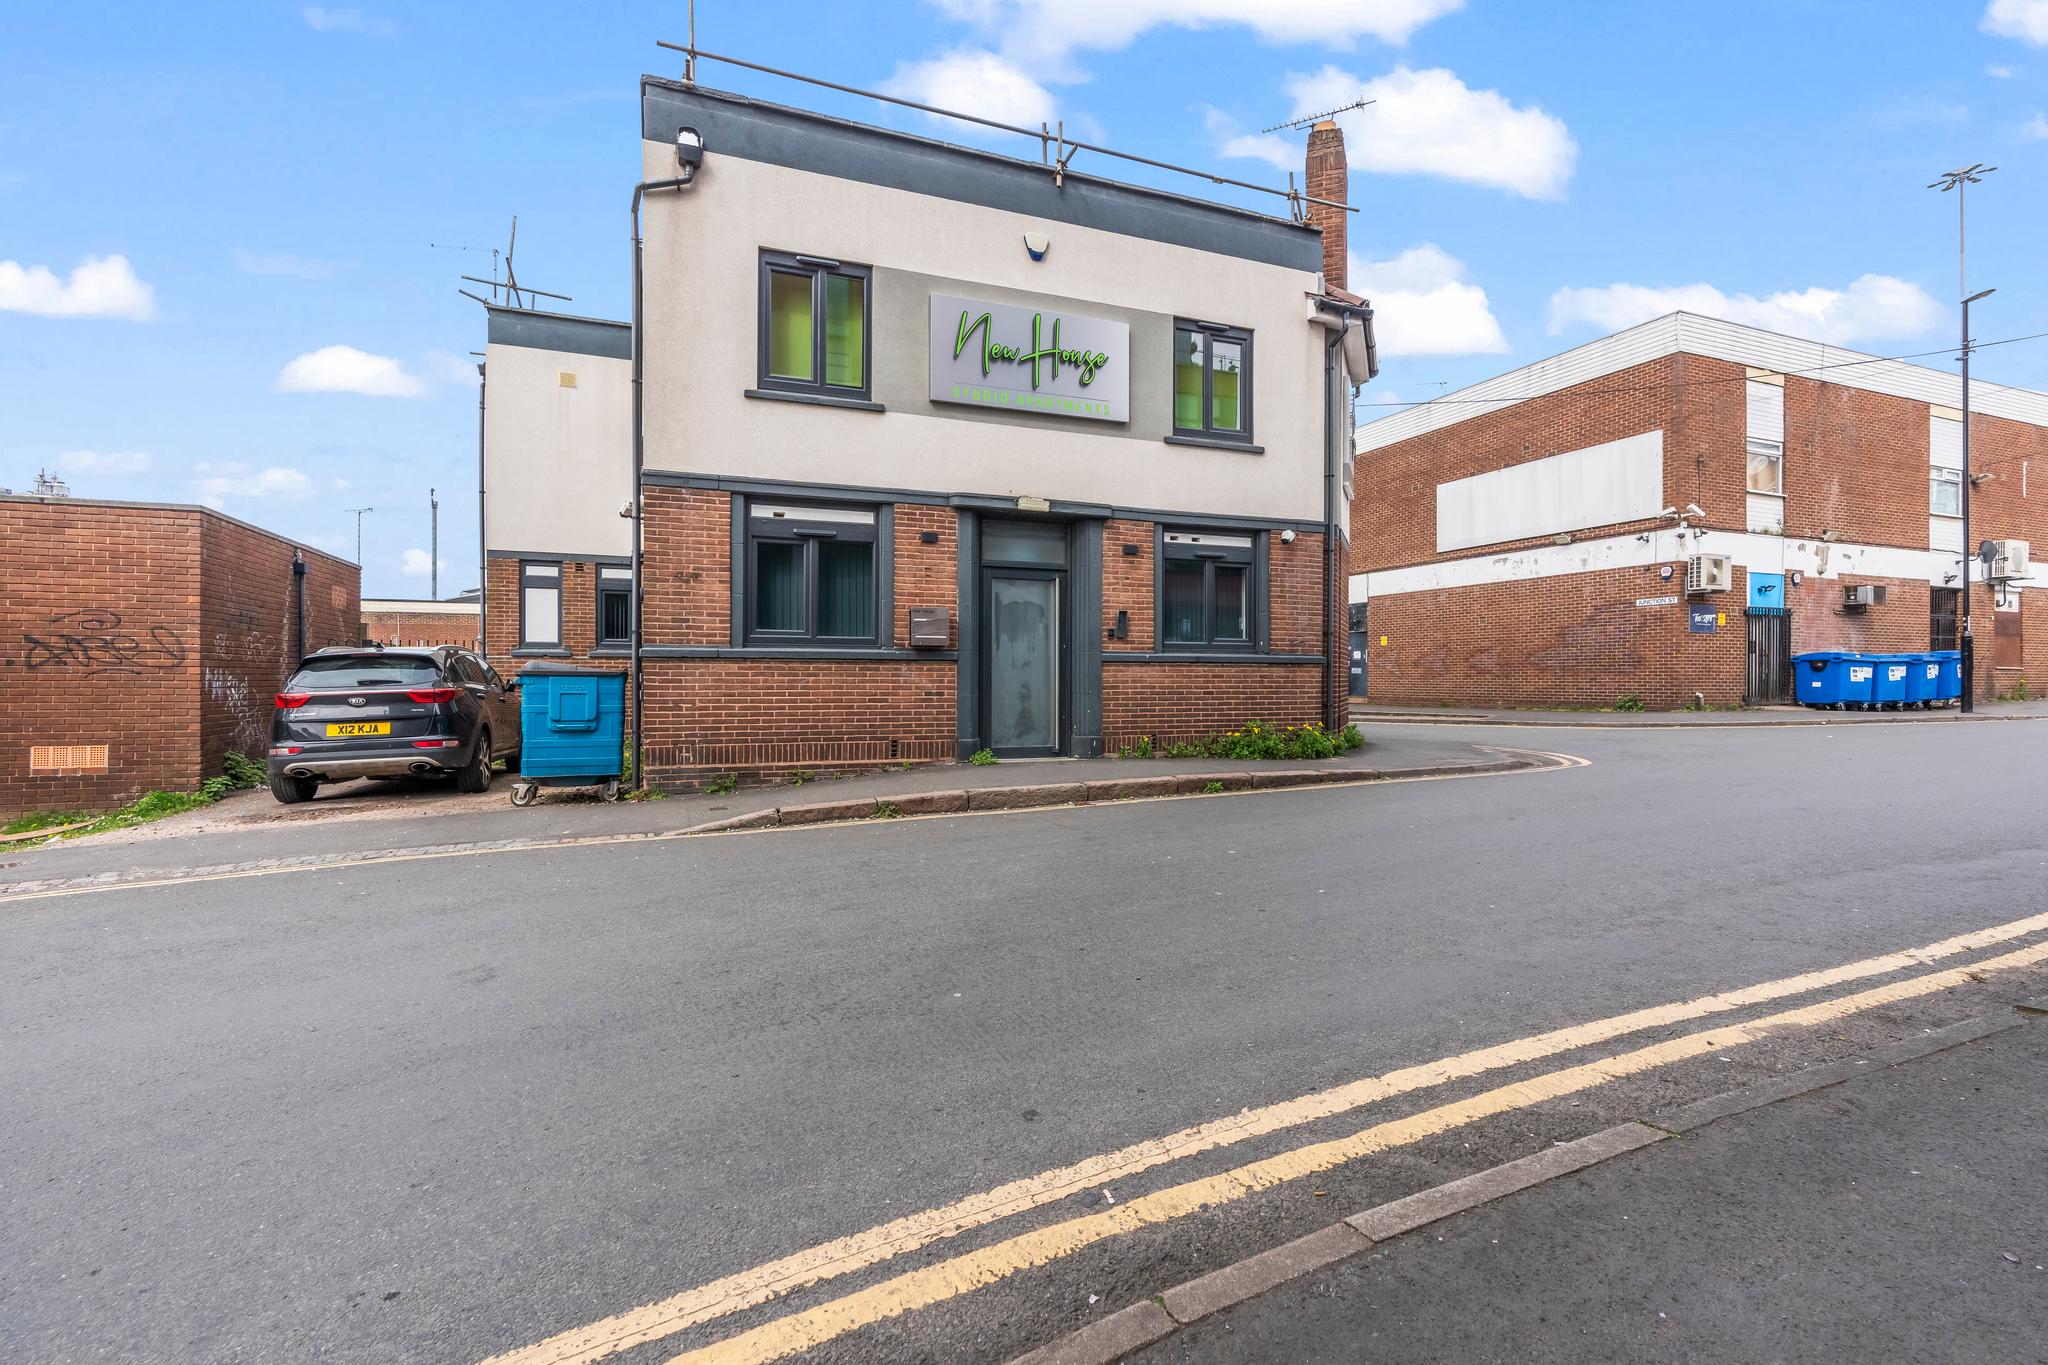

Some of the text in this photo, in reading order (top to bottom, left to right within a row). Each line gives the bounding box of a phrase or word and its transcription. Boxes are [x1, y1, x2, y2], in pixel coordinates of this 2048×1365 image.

[953, 310, 1109, 390] New House
[952, 385, 1110, 416] STUDIO APARTMENTS
[1638, 598, 1667, 606] JUNCTION
[357, 724, 379, 734] KJA
